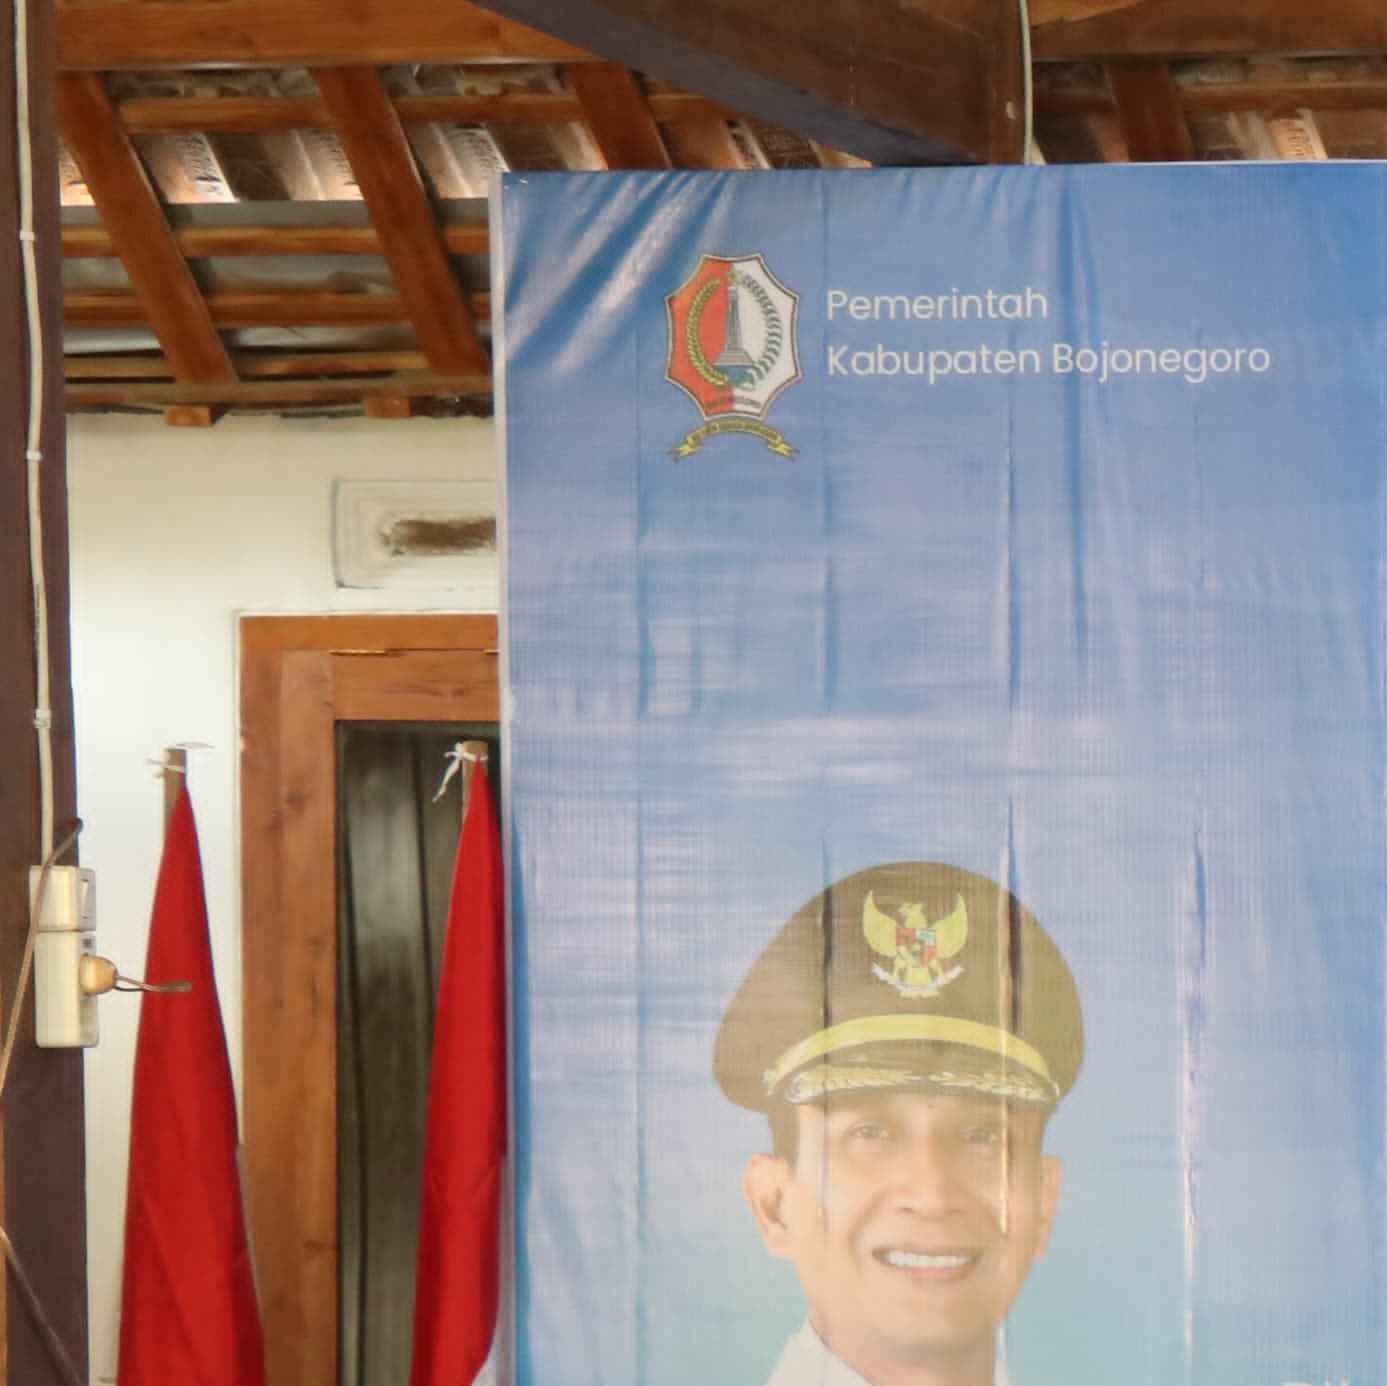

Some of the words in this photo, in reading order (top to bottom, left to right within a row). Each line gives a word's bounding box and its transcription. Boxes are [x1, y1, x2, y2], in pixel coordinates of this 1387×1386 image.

[826, 288, 1048, 320] Pemerintah
[827, 344, 1041, 383] Kabupaten
[1052, 341, 1271, 383] Bojonegoro
